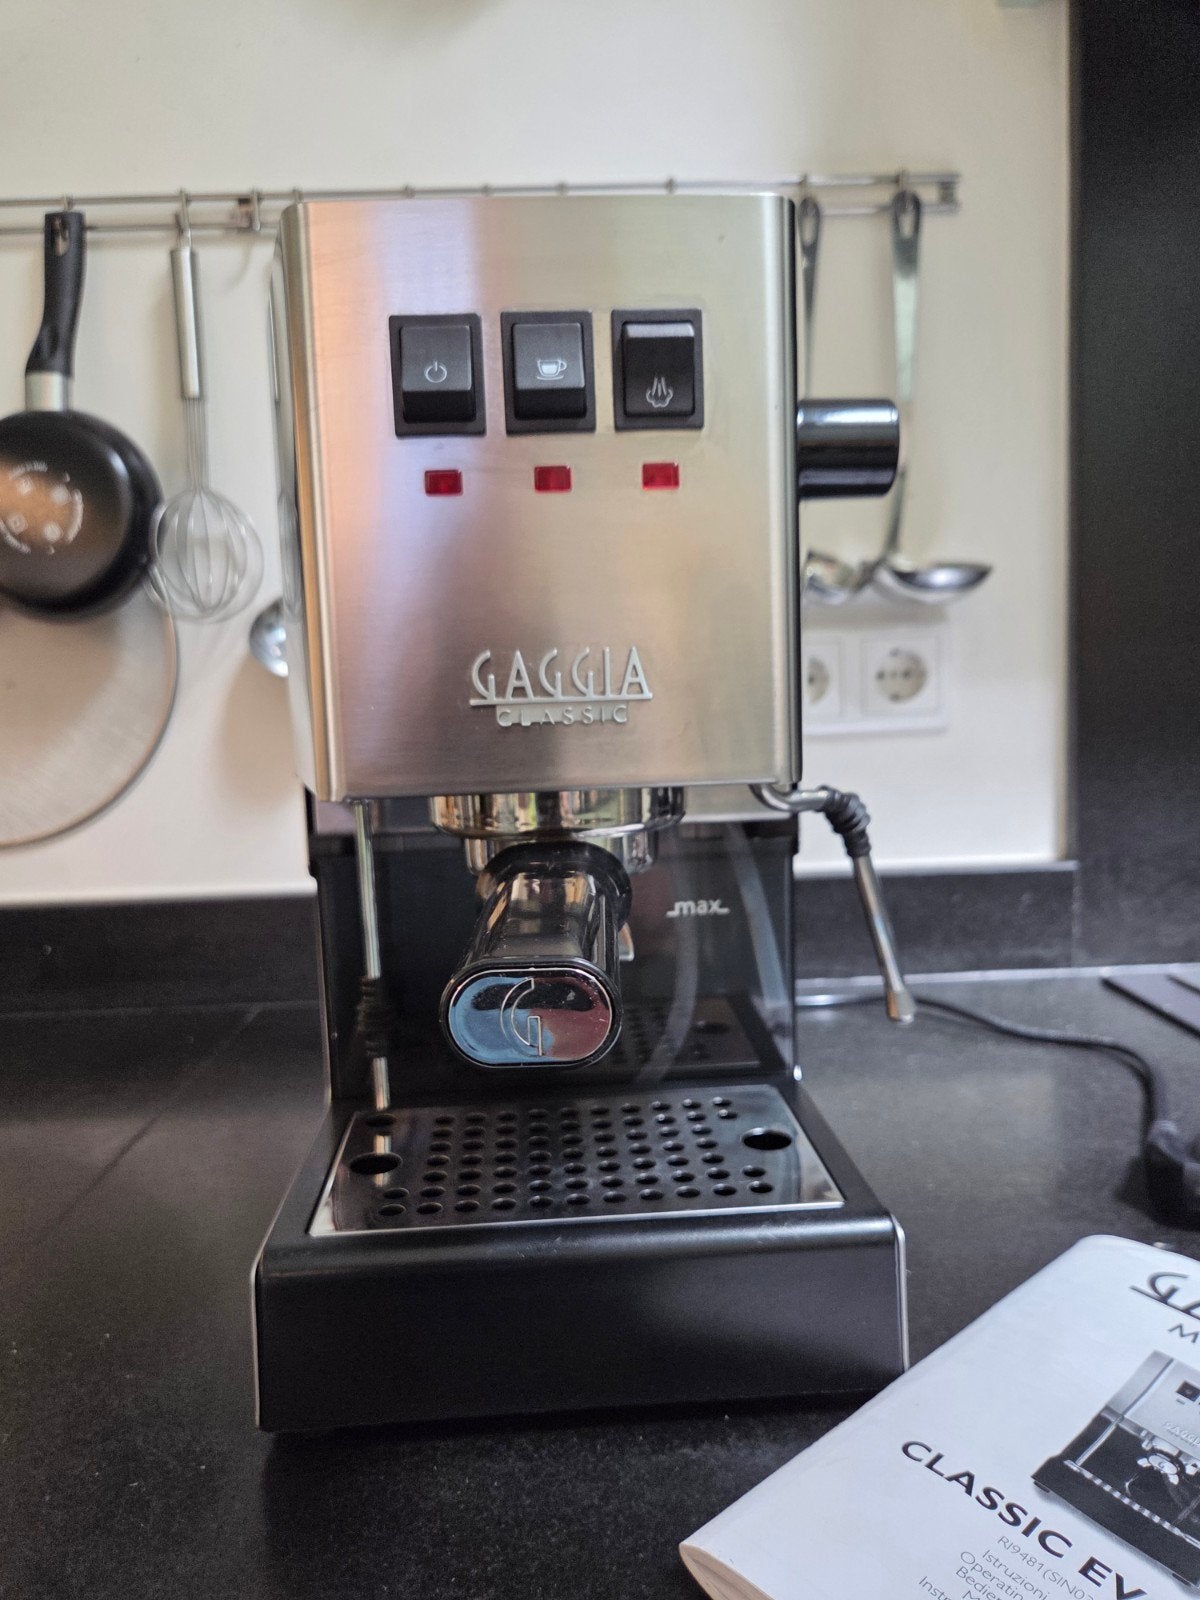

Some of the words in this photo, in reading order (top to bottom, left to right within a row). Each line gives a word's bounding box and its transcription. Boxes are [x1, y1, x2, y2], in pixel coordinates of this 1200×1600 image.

[470, 646, 653, 704] GAGGIA
[496, 704, 628, 727] CLASSIC
[672, 898, 724, 917] max
[901, 1440, 1073, 1558] CLASSIC
[982, 1549, 1051, 1600] Istruzioni
